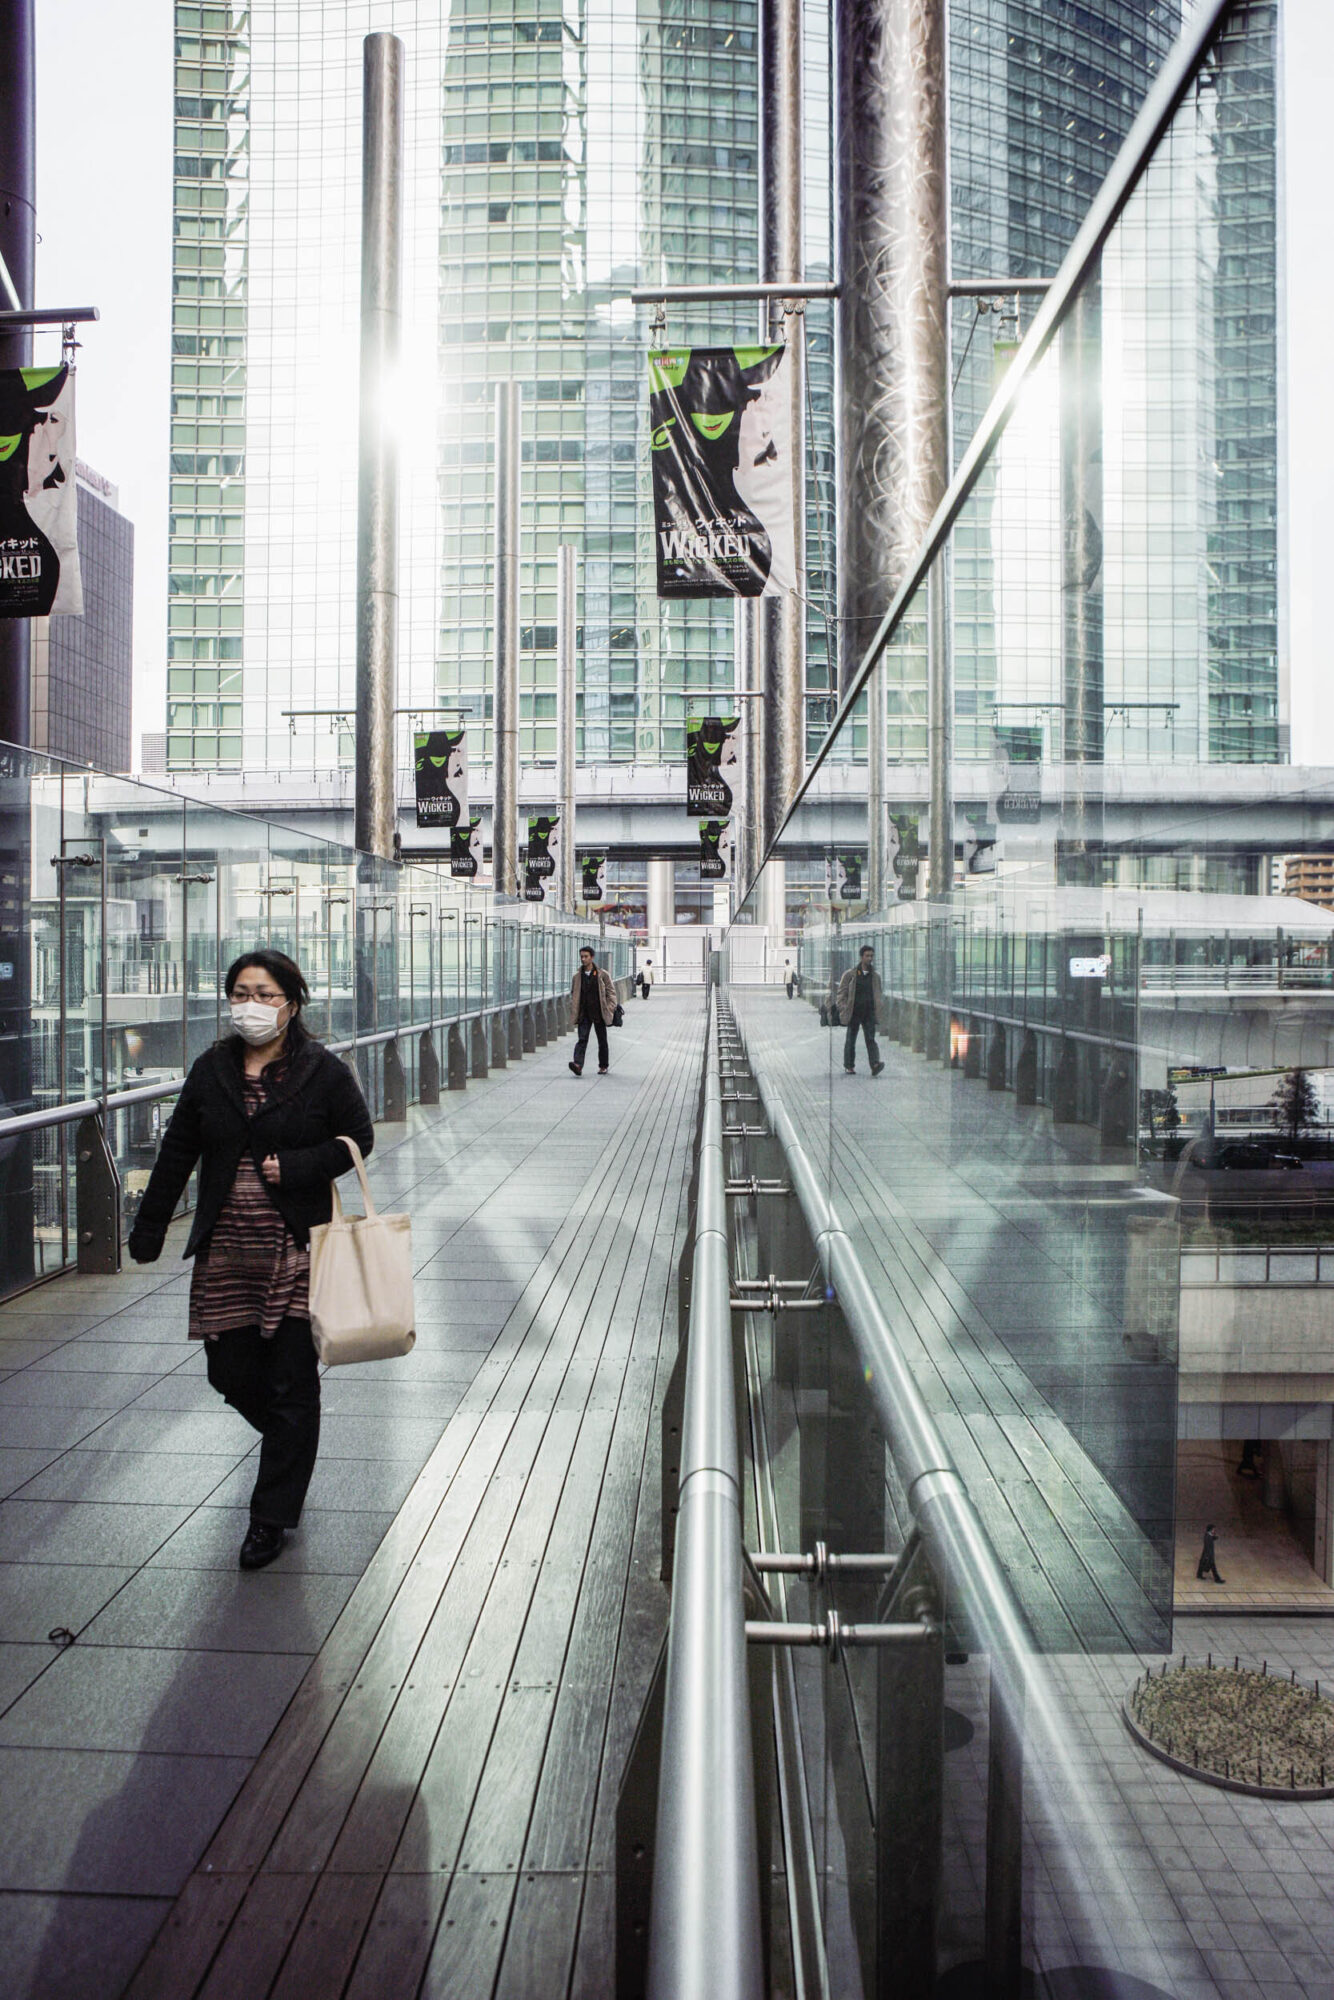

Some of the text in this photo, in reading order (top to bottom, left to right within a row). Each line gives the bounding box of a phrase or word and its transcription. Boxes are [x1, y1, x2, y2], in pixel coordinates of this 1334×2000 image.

[695, 516, 747, 529] ウィキッド
[659, 531, 750, 558] WICKED
[0, 555, 41, 579] KED
[689, 788, 725, 801] WICKED
[418, 801, 453, 813] WICKED
